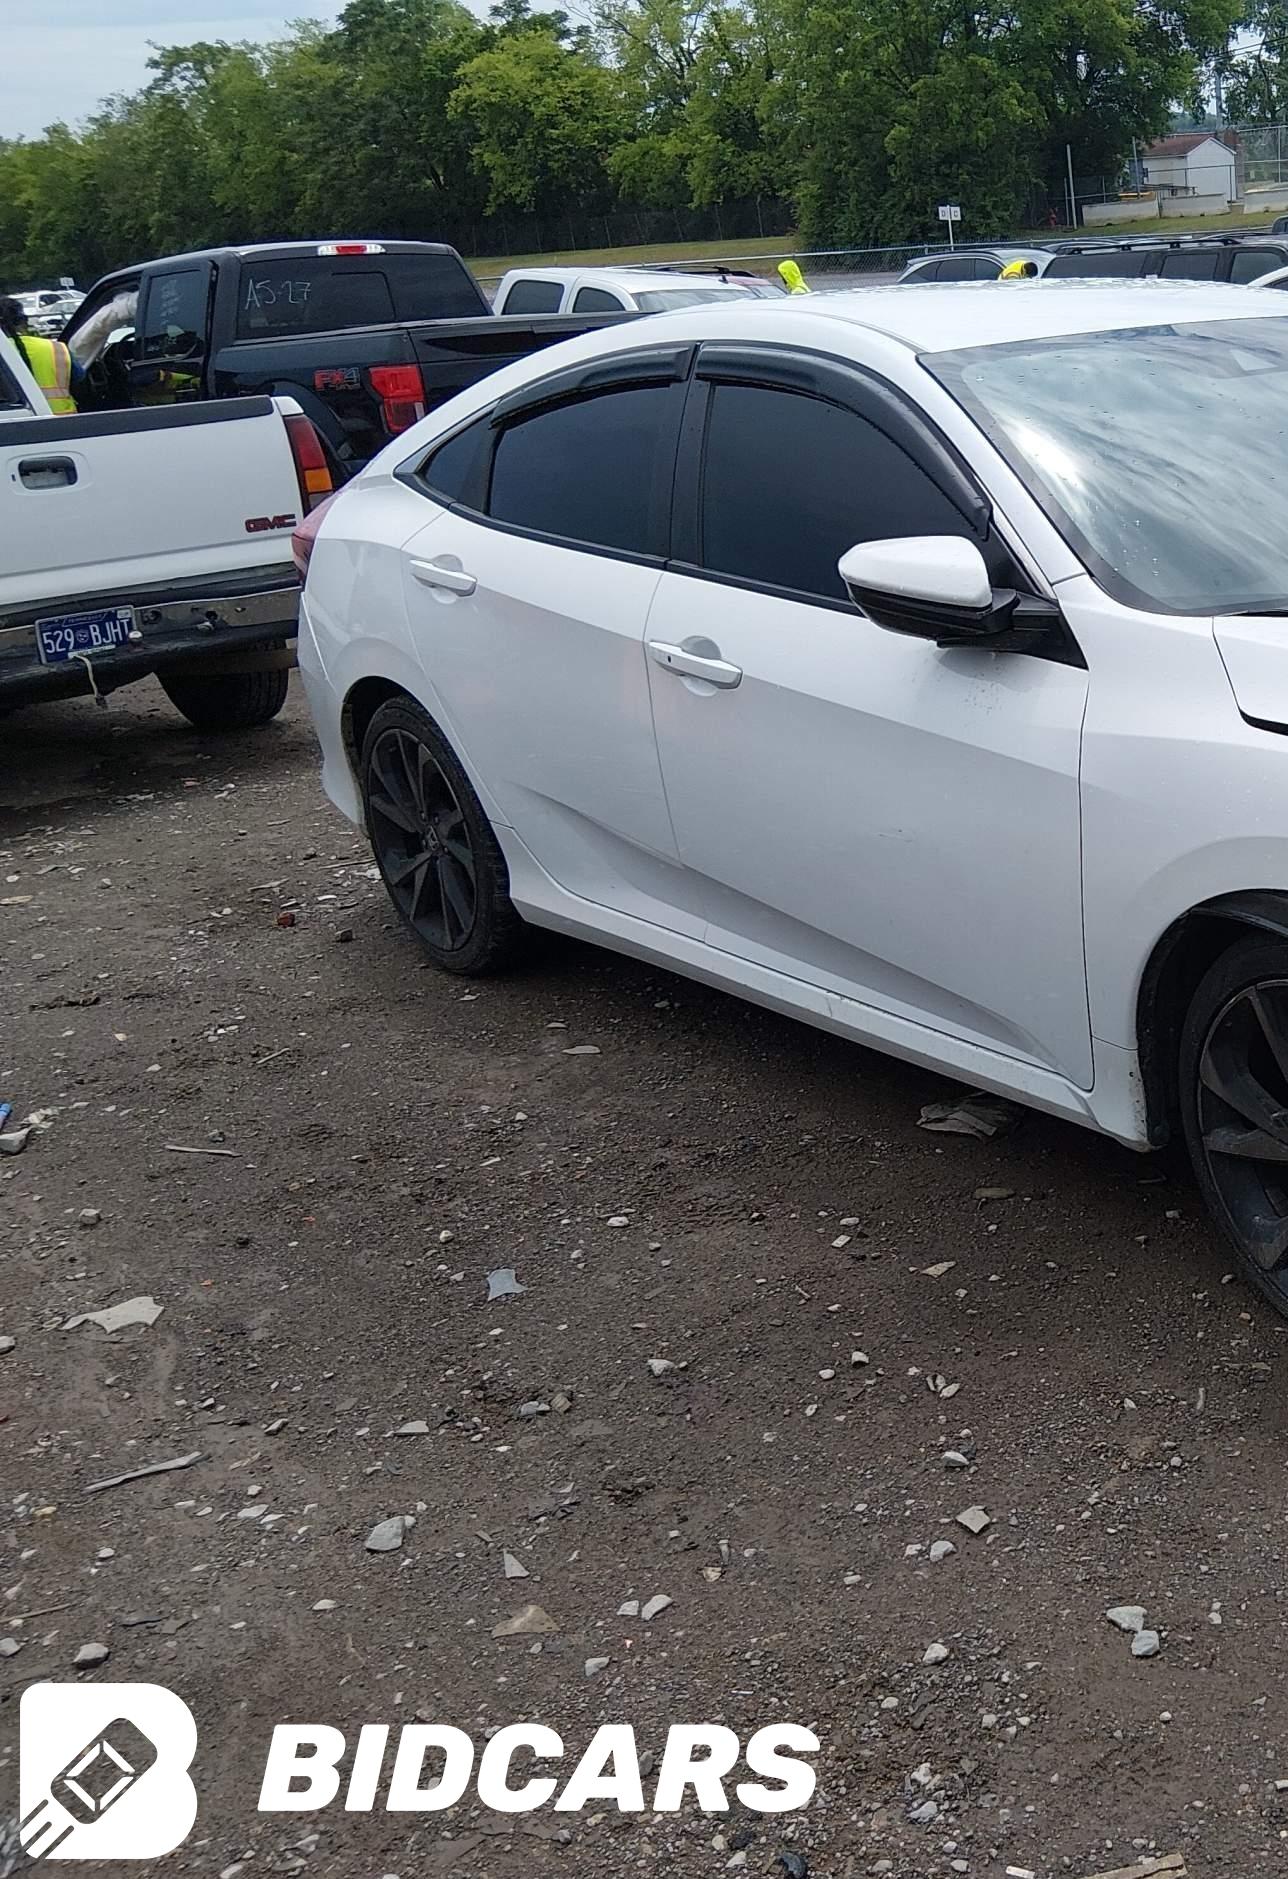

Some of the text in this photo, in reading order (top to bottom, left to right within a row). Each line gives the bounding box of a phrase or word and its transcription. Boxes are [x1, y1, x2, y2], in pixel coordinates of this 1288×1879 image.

[314, 367, 360, 391] FX4
[245, 514, 297, 533] GMC
[42, 628, 75, 654] 529
[89, 619, 130, 646] BJHT
